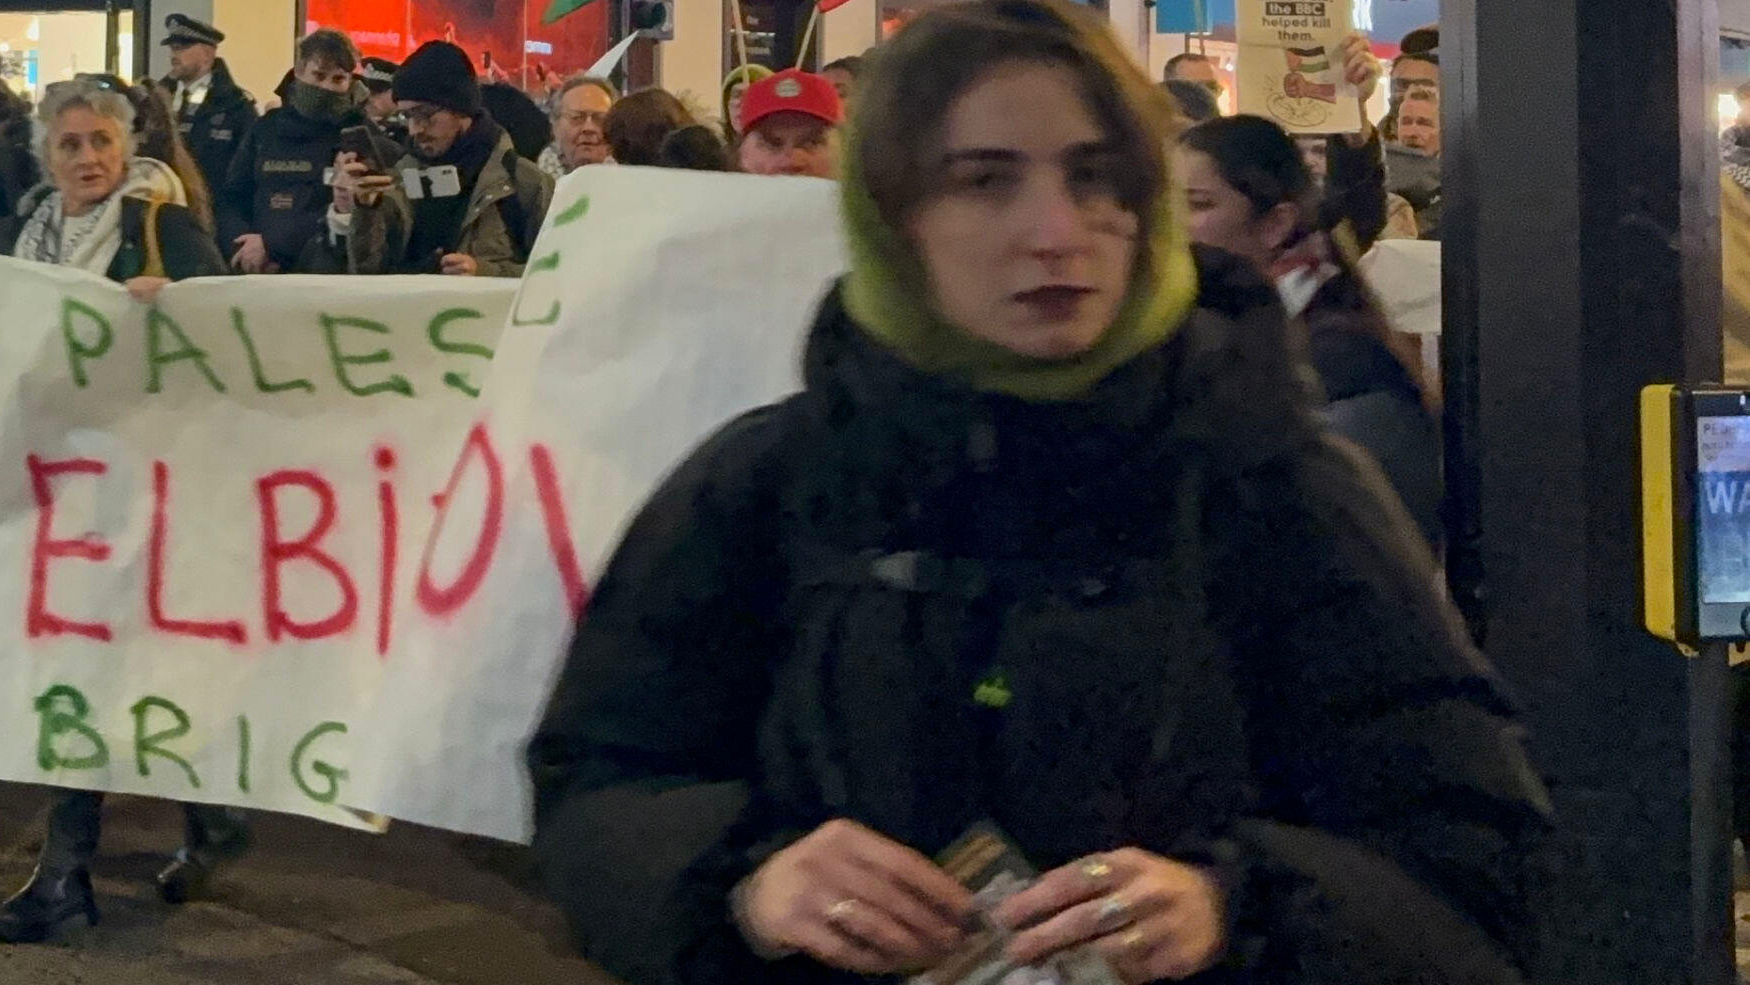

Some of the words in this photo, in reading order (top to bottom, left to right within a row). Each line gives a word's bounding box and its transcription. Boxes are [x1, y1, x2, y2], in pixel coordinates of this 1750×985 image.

[1269, 3, 1291, 15] the
[1295, 3, 1322, 15] BBC
[1262, 17, 1308, 30] helped
[1312, 17, 1331, 28] kill
[35, 683, 348, 805] BRIG
